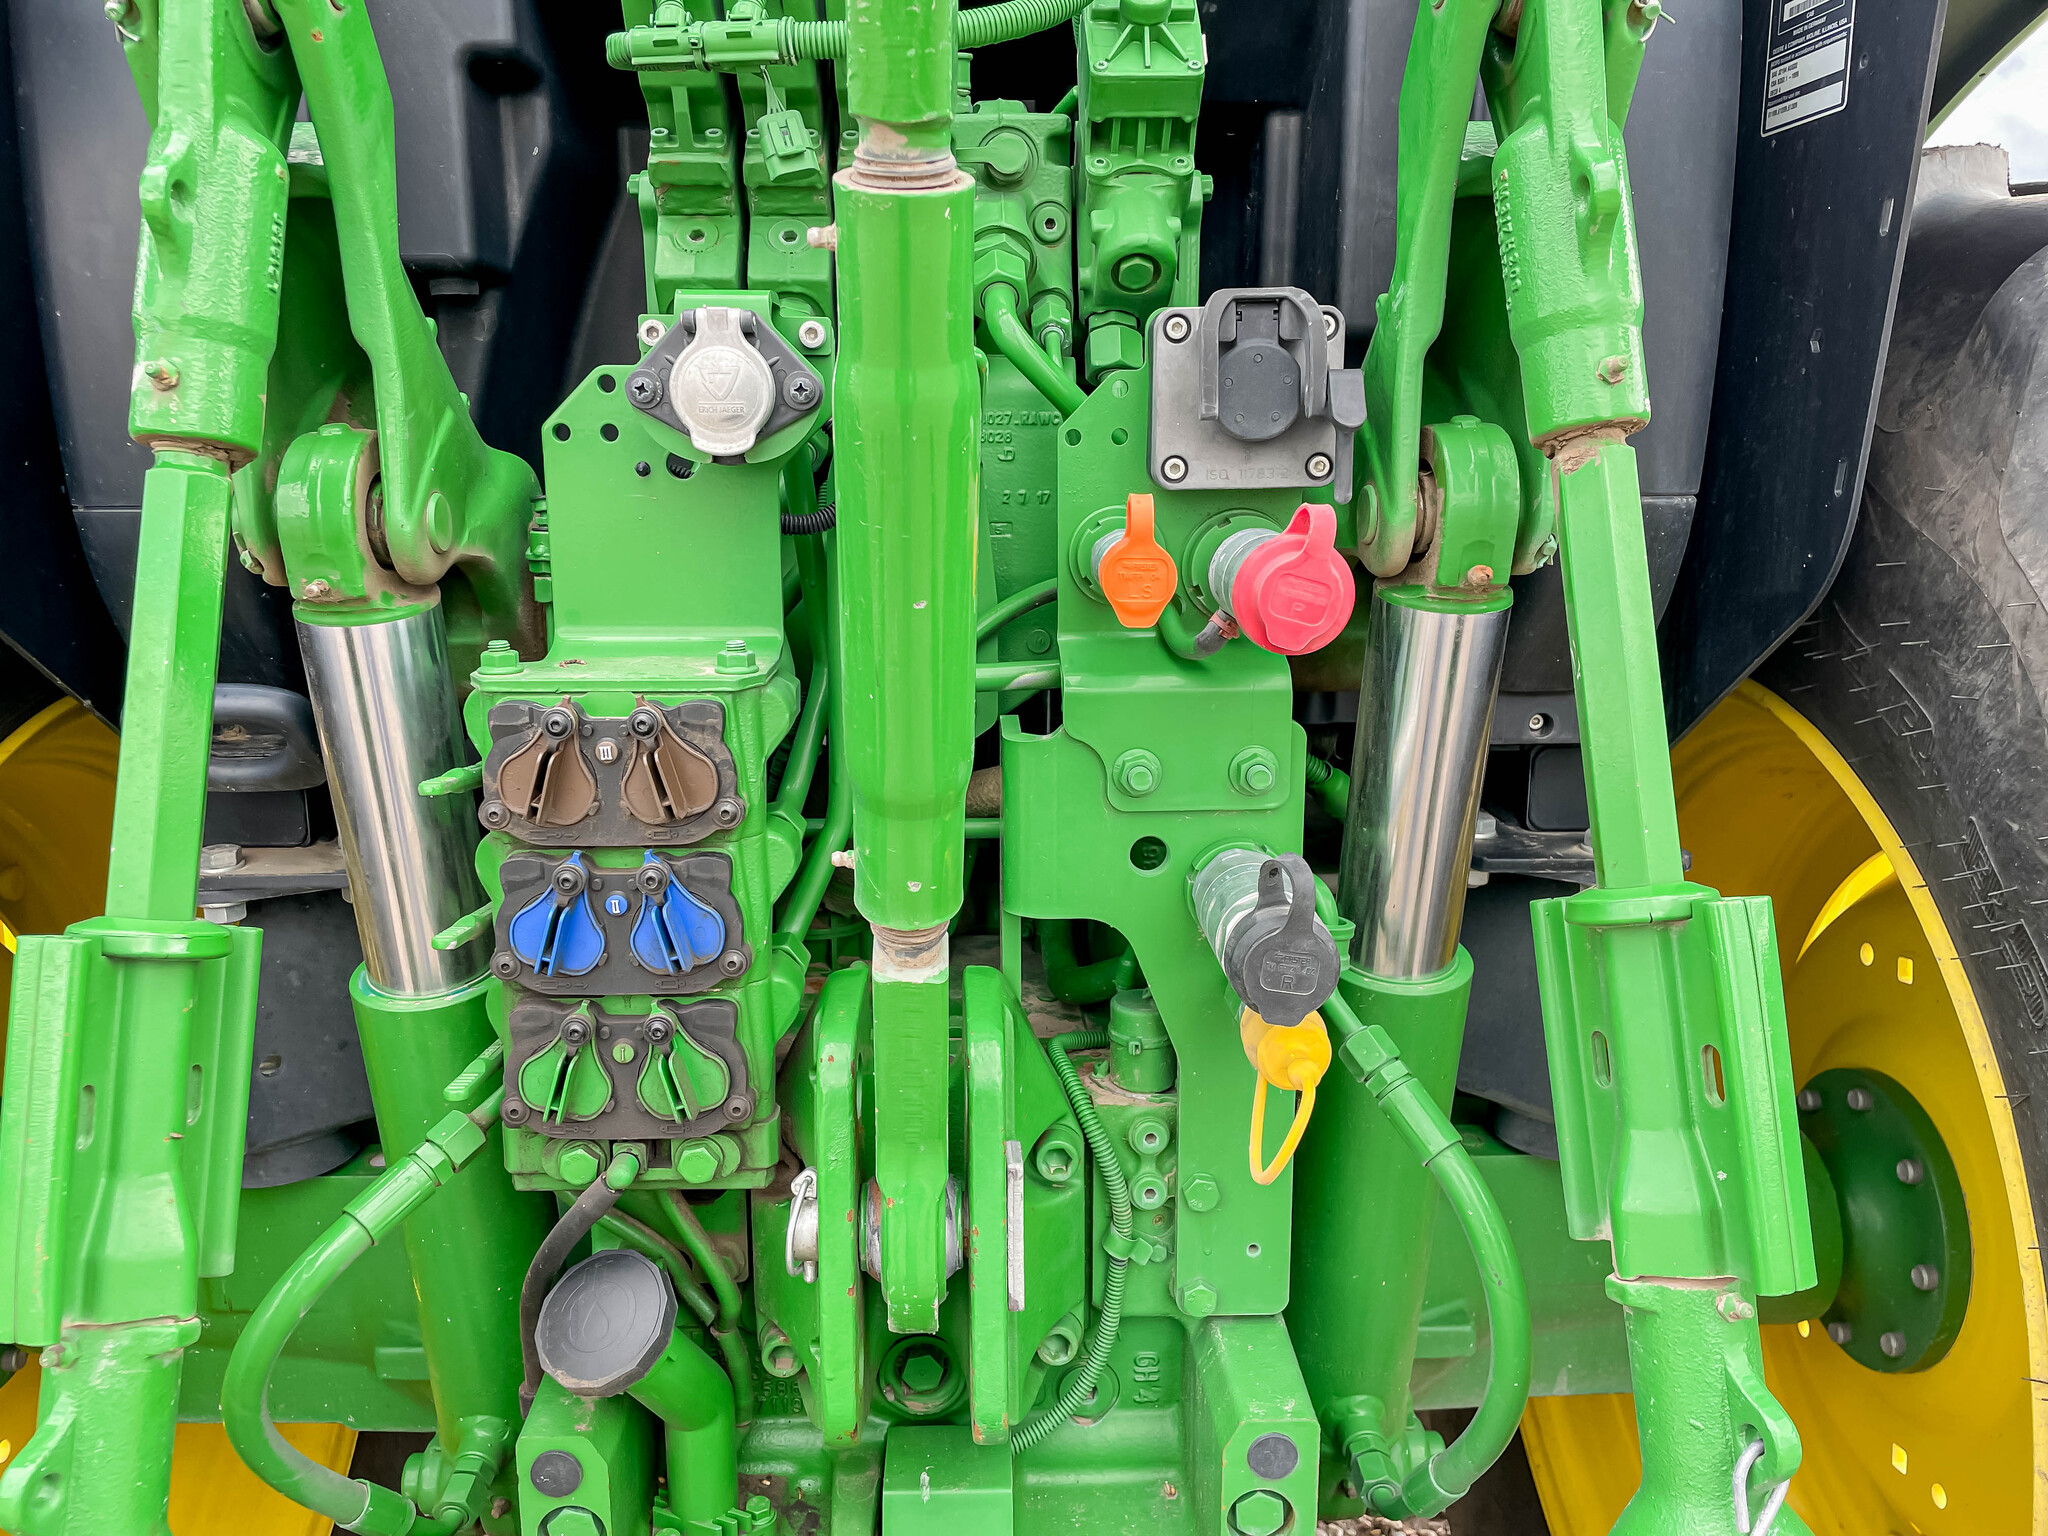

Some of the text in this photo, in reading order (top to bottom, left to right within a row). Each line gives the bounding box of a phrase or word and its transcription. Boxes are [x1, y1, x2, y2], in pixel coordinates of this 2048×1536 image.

[698, 406, 745, 414] ERICH JAEGER
[1281, 974, 1295, 990] R
